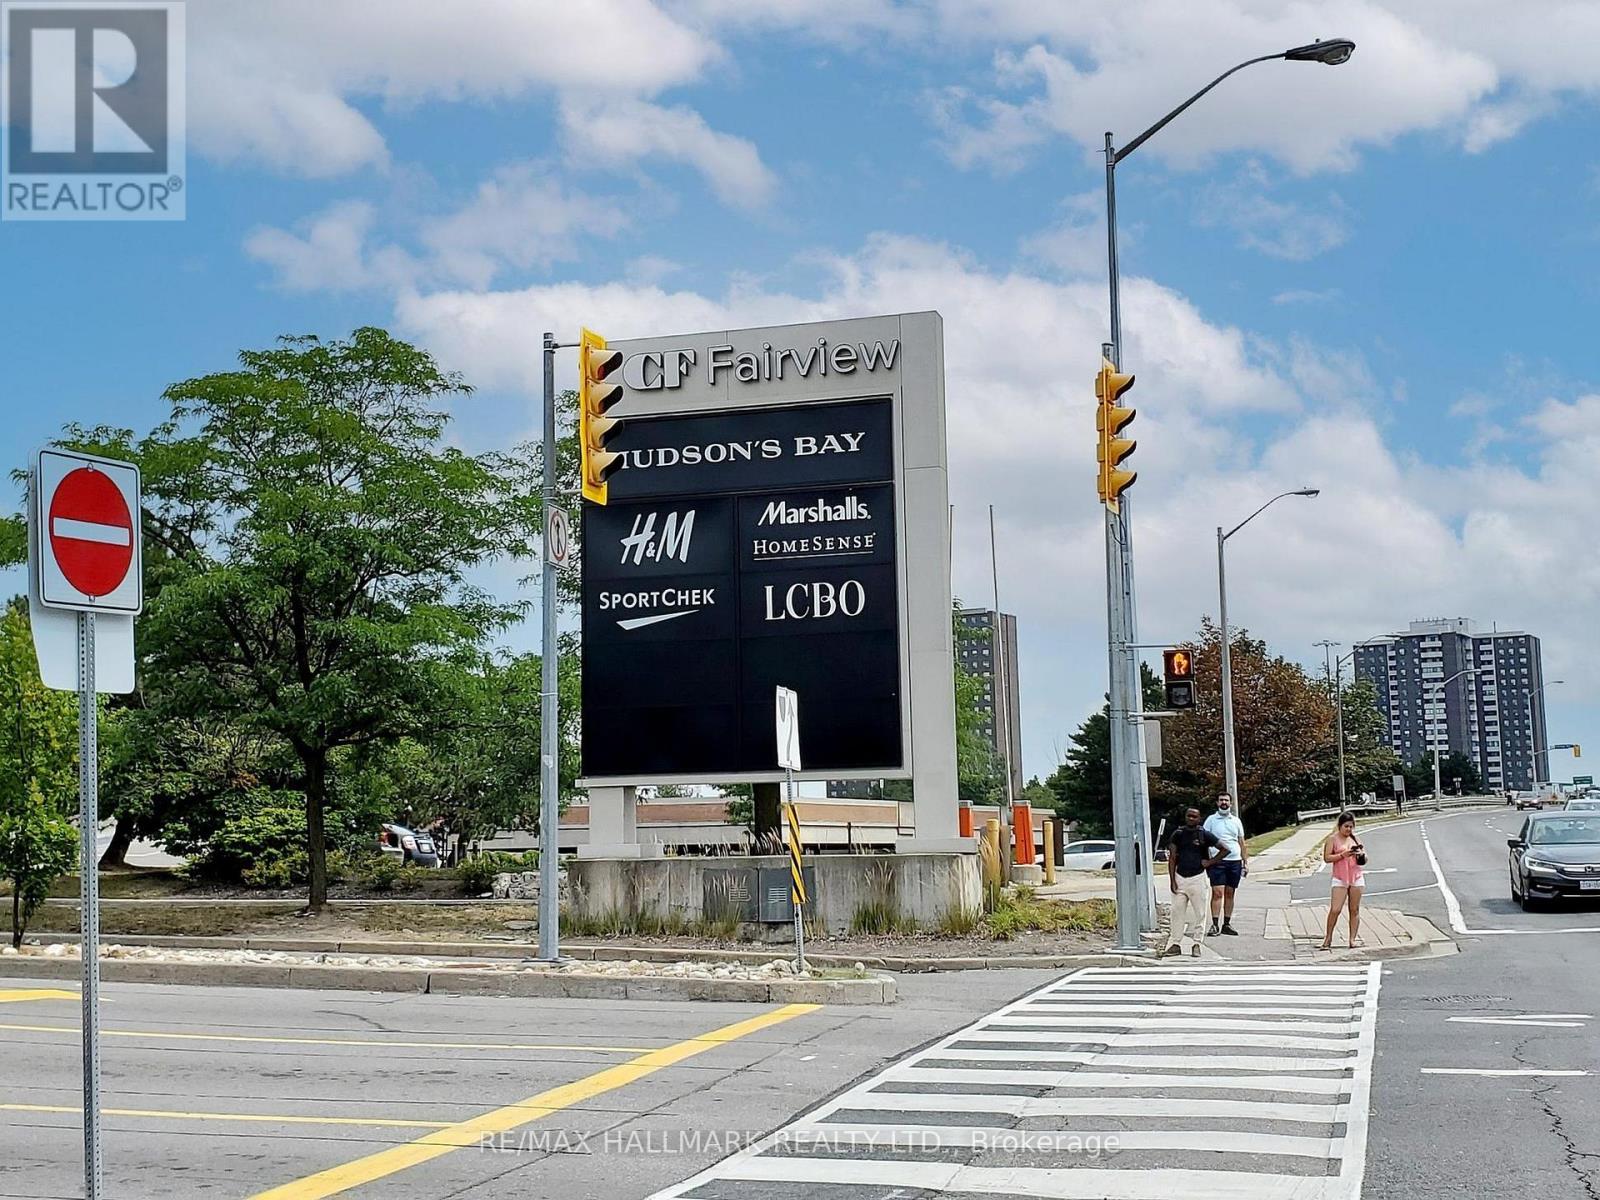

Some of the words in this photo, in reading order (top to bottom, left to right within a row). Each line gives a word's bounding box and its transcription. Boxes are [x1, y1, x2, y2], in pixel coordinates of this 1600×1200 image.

[622, 349, 697, 391] CF
[707, 337, 900, 385] Fairview
[794, 432, 866, 456] BAY
[620, 510, 696, 565] H&M
[599, 588, 716, 610] SPORTCHEK
[764, 580, 866, 621] LCBO
